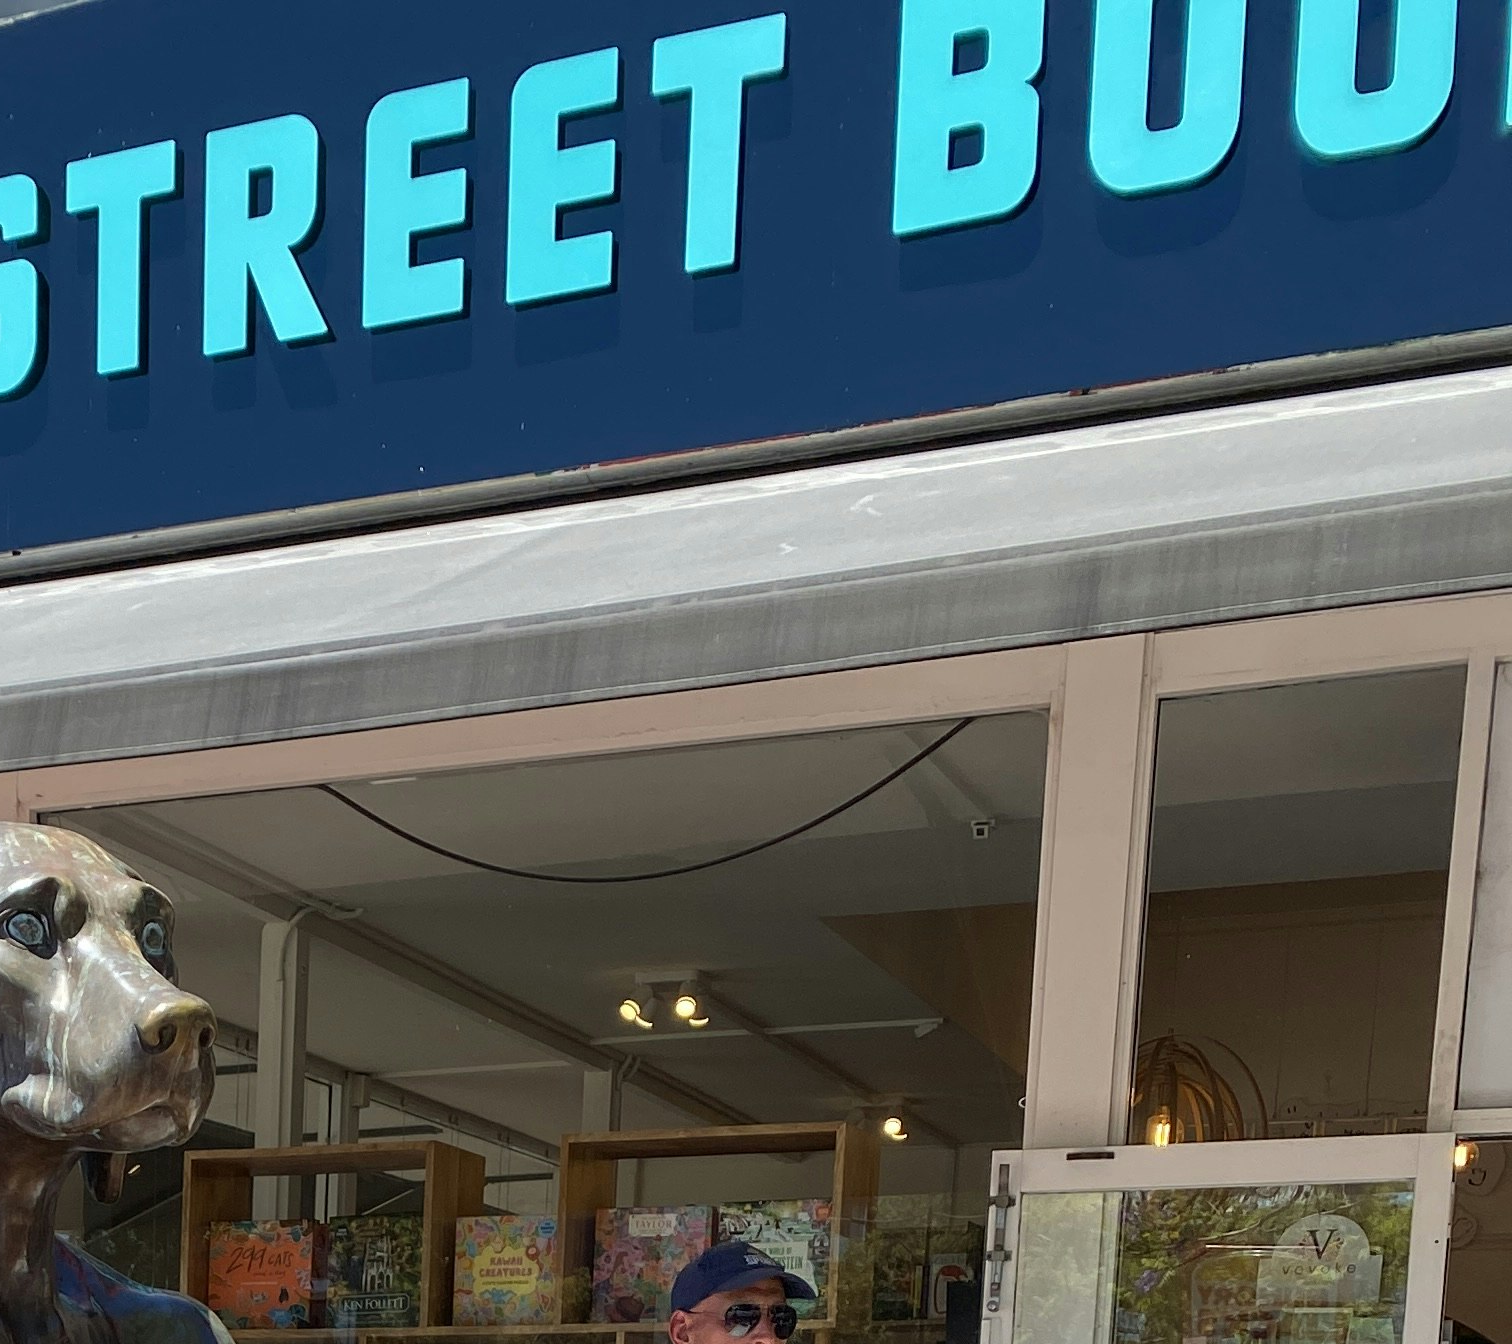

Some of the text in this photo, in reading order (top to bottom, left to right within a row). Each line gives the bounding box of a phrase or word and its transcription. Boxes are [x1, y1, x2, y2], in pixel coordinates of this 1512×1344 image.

[892, 0, 1512, 238] BOO
[343, 1297, 405, 1311] KEN FOLLETT
